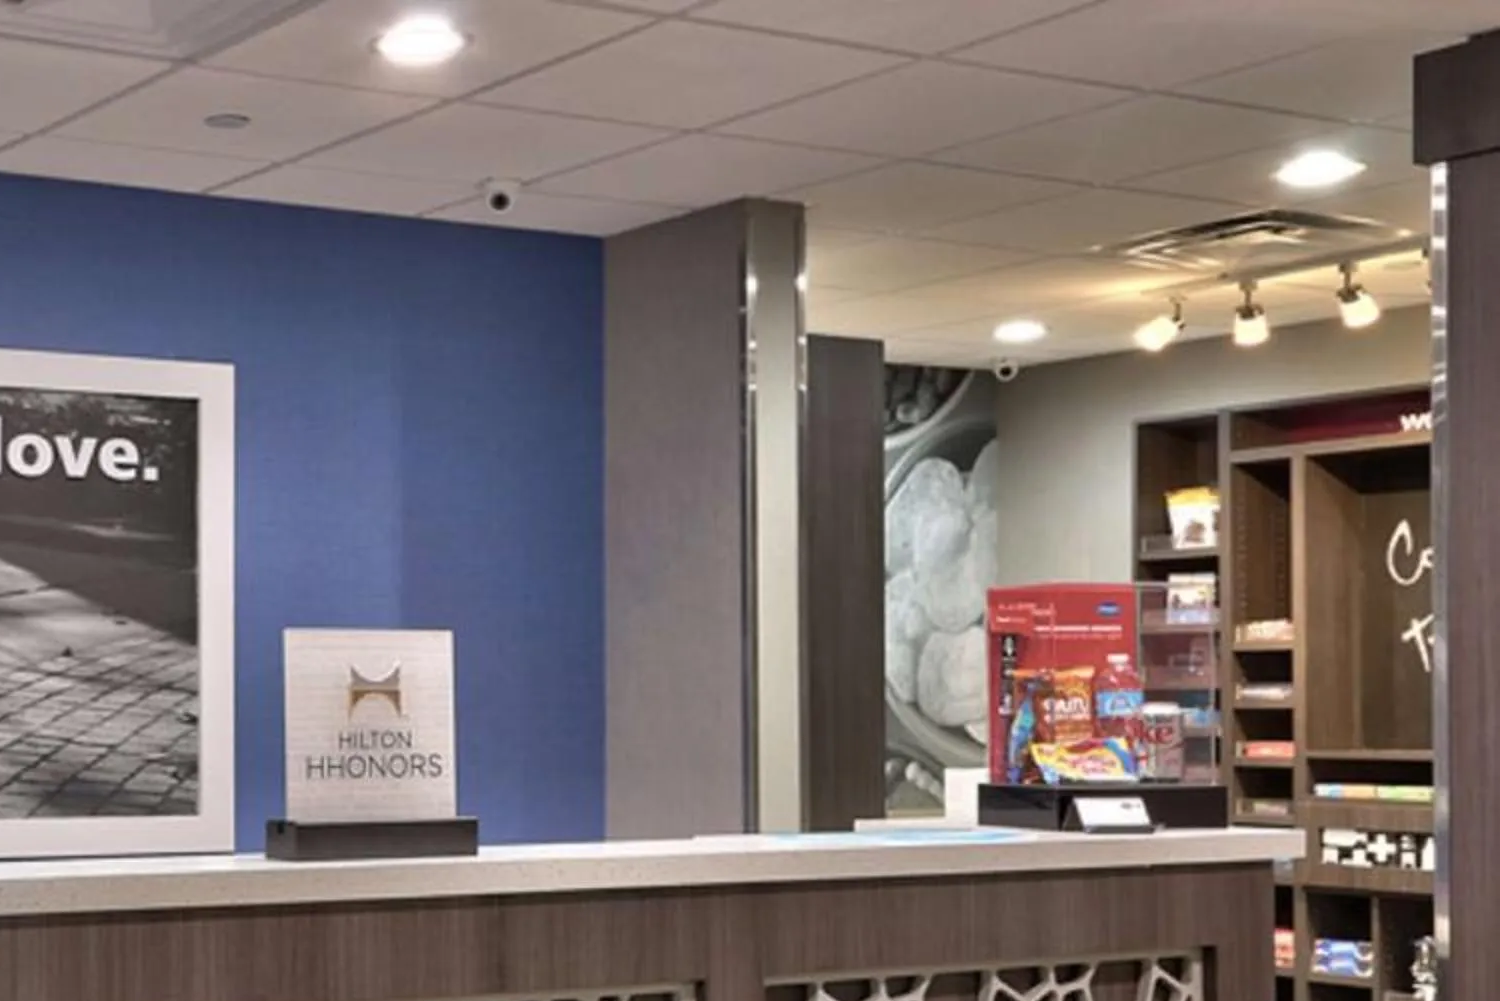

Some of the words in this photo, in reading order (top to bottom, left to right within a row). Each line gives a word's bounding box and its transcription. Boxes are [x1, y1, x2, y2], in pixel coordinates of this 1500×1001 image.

[1401, 613, 1436, 673] T
[338, 729, 413, 749] HILTON
[305, 752, 443, 779] HHONORS
